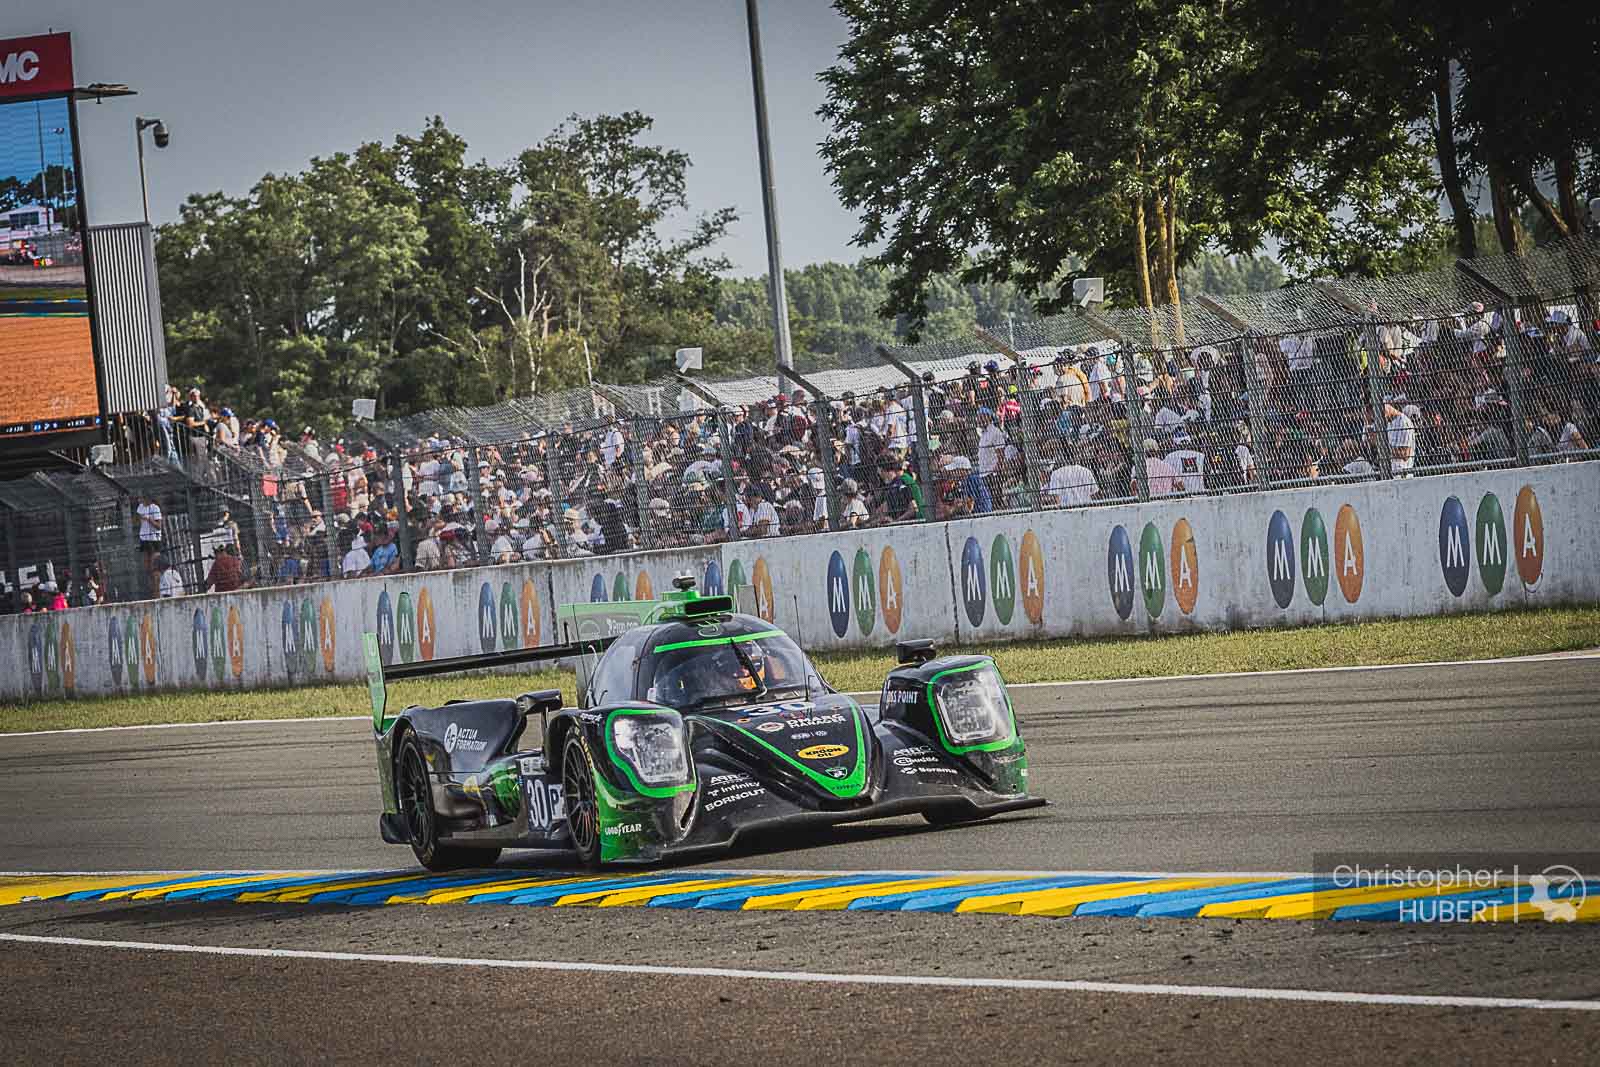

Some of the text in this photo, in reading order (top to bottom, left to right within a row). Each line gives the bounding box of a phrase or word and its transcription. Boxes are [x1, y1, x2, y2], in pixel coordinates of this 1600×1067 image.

[898, 690, 919, 704] POINT
[457, 727, 478, 740] ACTUA
[721, 781, 760, 793] Infinity
[527, 779, 549, 828] 30
